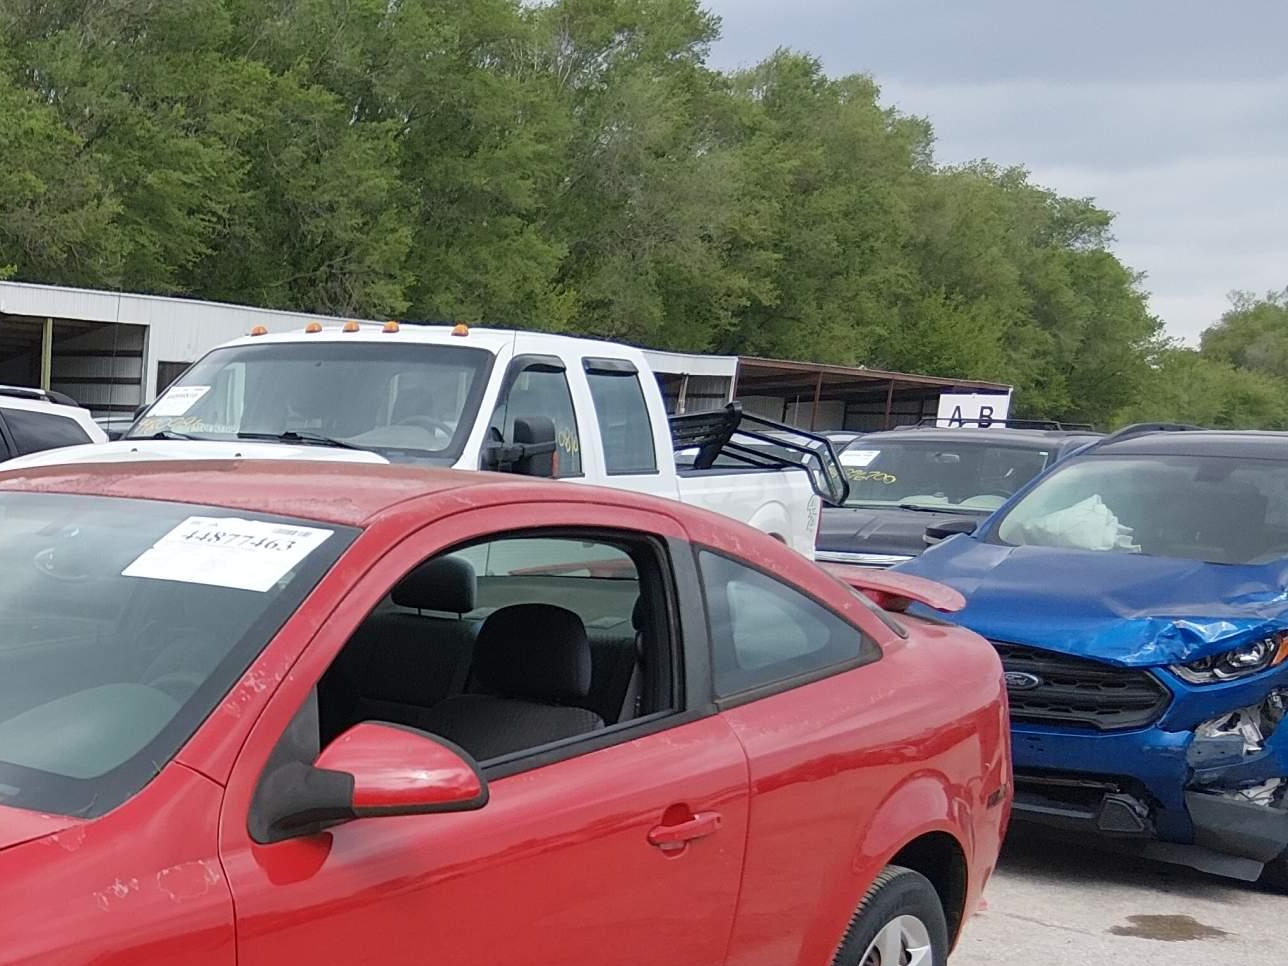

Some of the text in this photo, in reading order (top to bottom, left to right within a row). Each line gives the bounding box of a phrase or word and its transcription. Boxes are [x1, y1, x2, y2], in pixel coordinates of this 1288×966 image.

[948, 405, 994, 428] A B
[182, 529, 296, 551] 44877463
